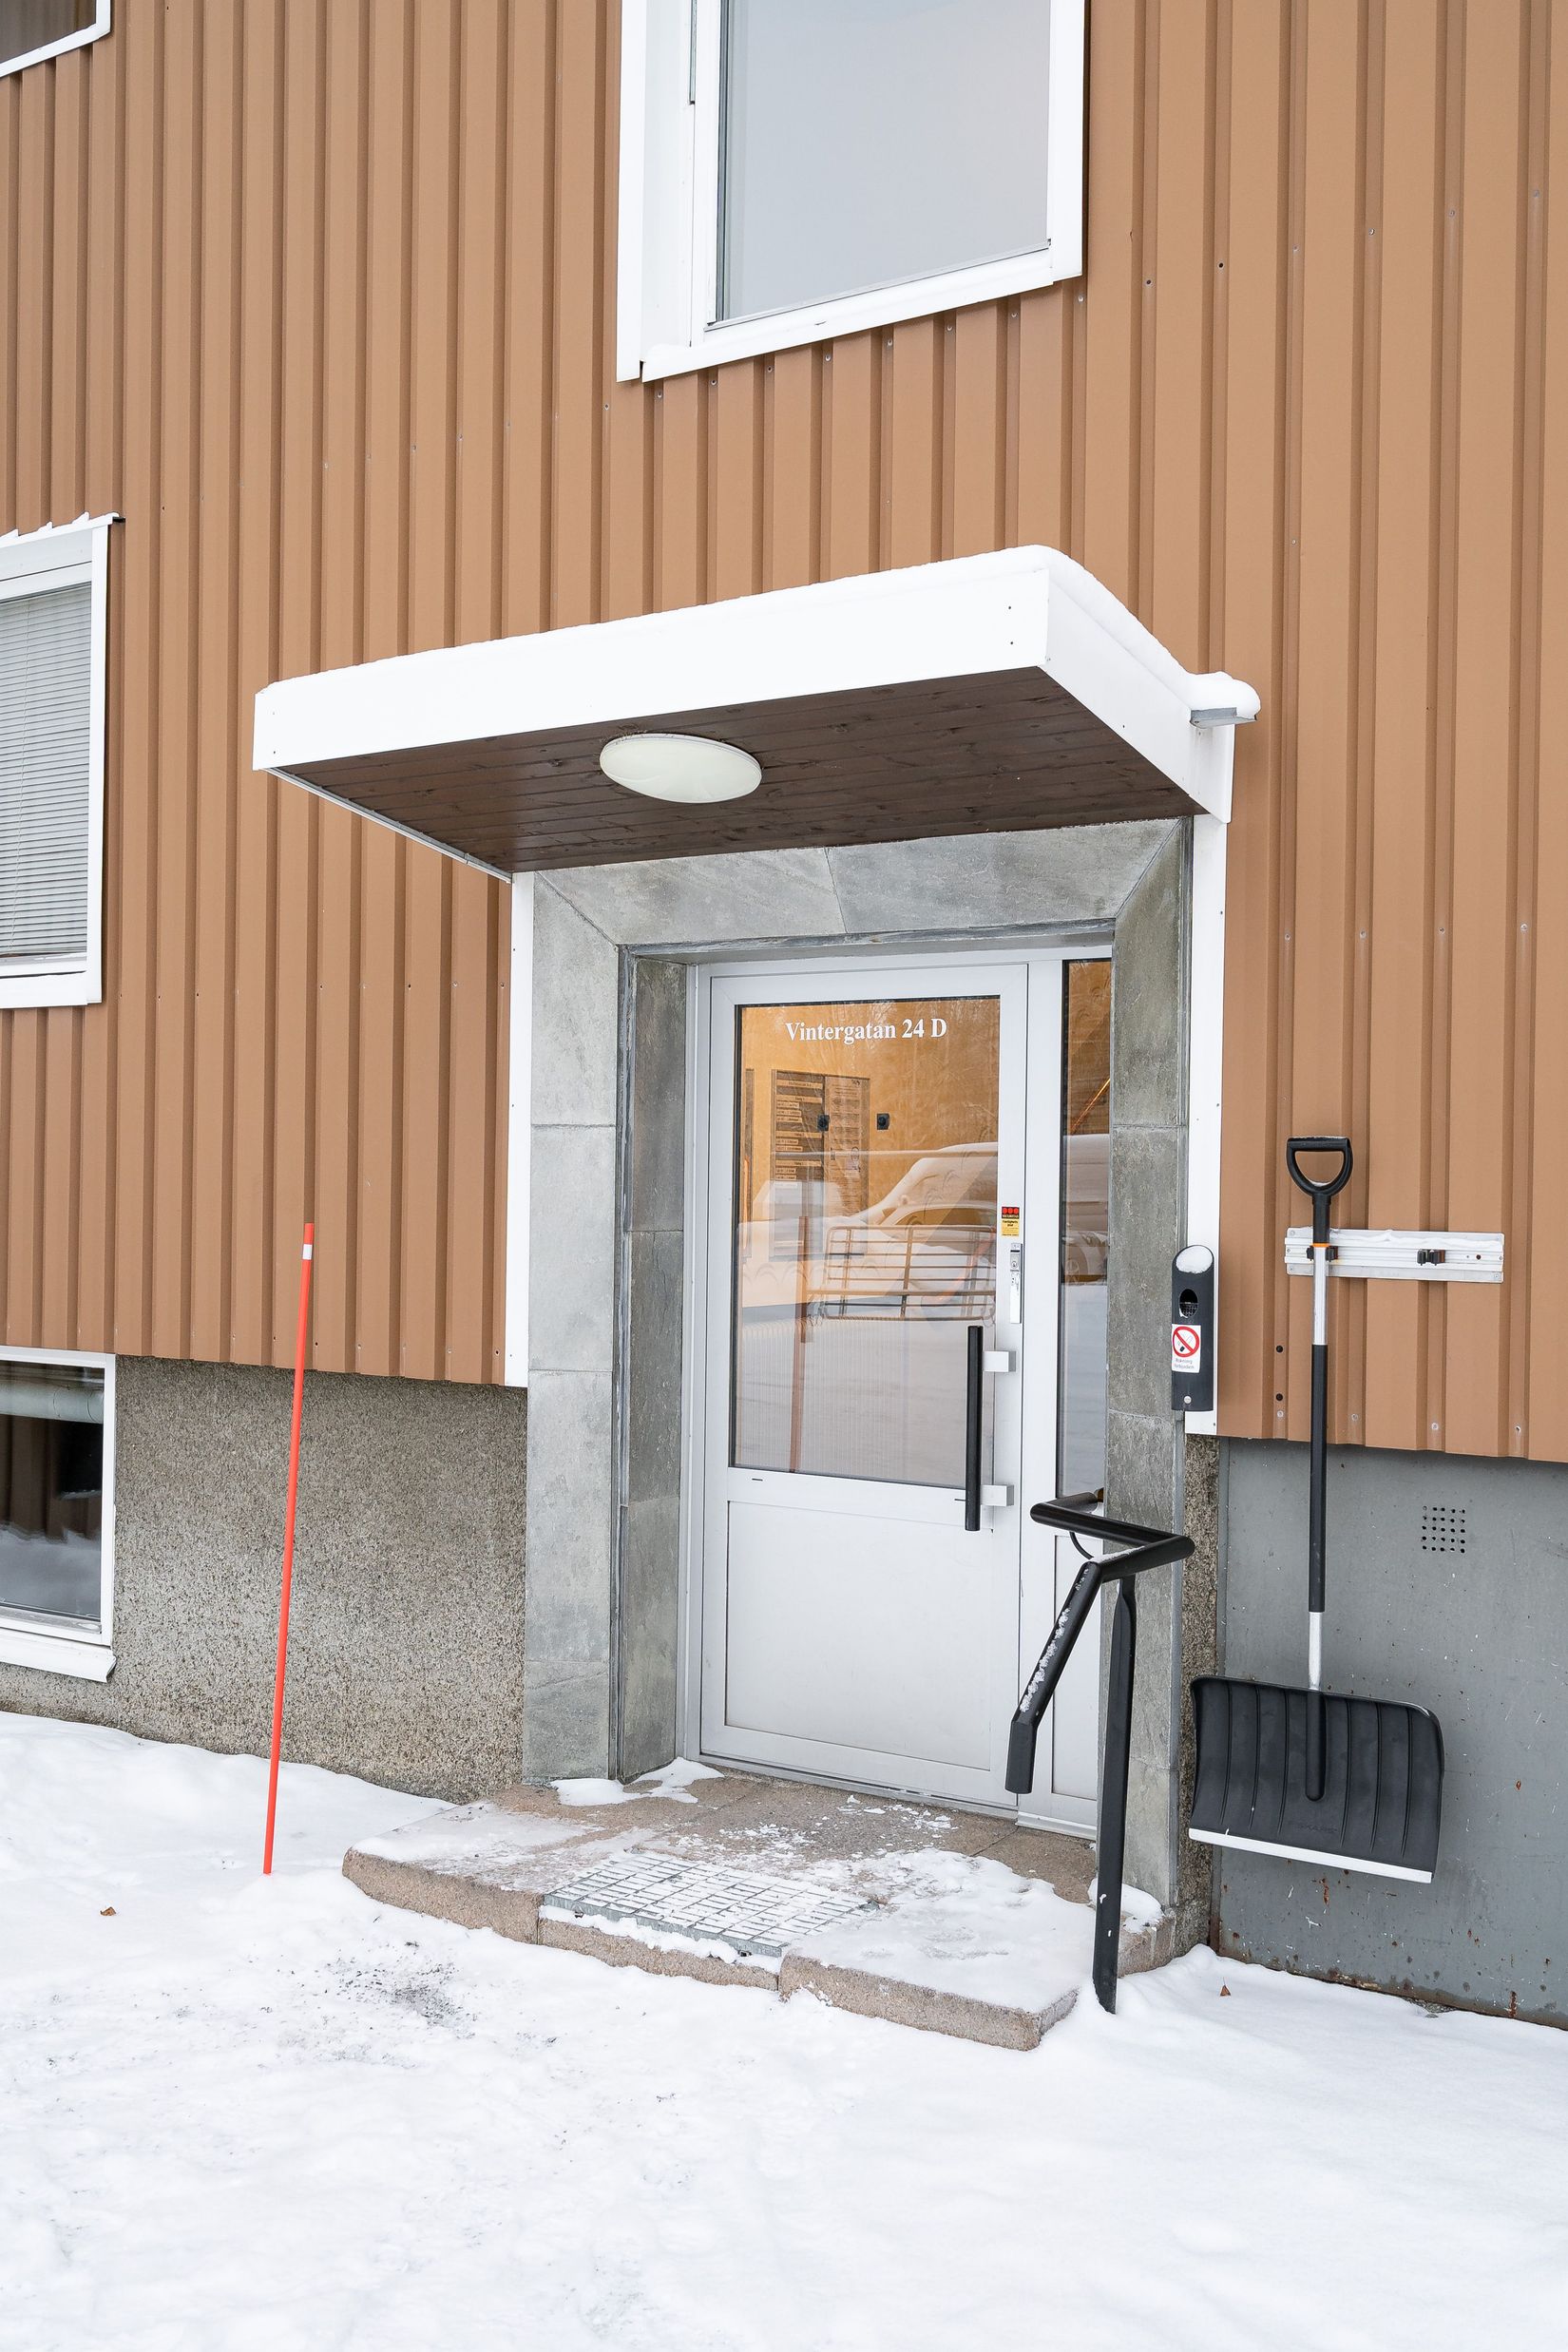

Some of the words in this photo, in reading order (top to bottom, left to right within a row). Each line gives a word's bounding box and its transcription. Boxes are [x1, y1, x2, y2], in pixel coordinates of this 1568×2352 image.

[785, 1021, 896, 1045] Vintergatan
[902, 1018, 925, 1039] 24
[930, 1018, 947, 1038] D
